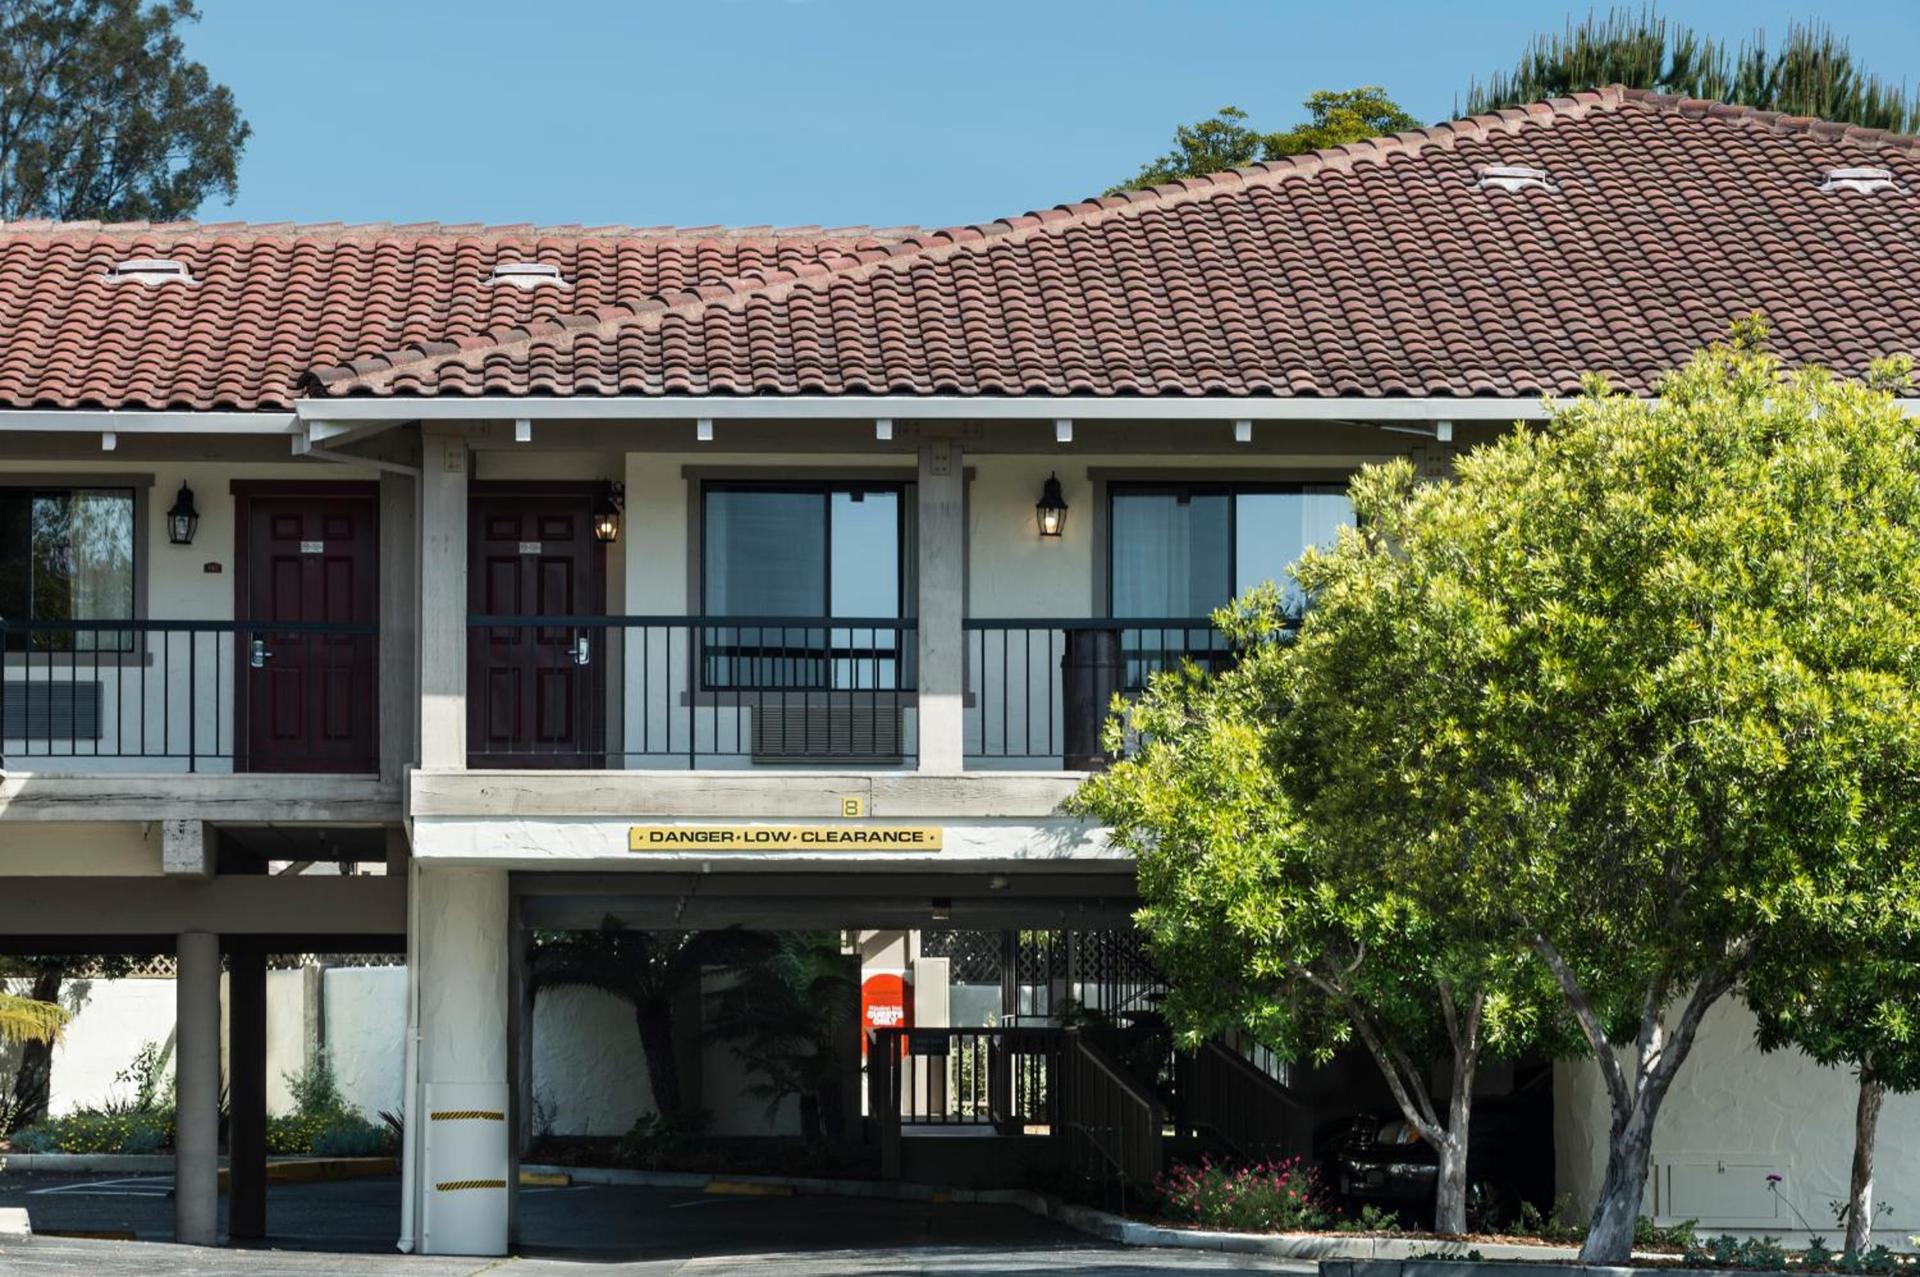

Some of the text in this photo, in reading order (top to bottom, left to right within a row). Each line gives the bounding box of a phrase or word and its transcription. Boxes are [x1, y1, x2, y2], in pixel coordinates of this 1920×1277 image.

[845, 800, 858, 815] 8
[649, 831, 923, 843] DANGER LOW CLEARANCE
